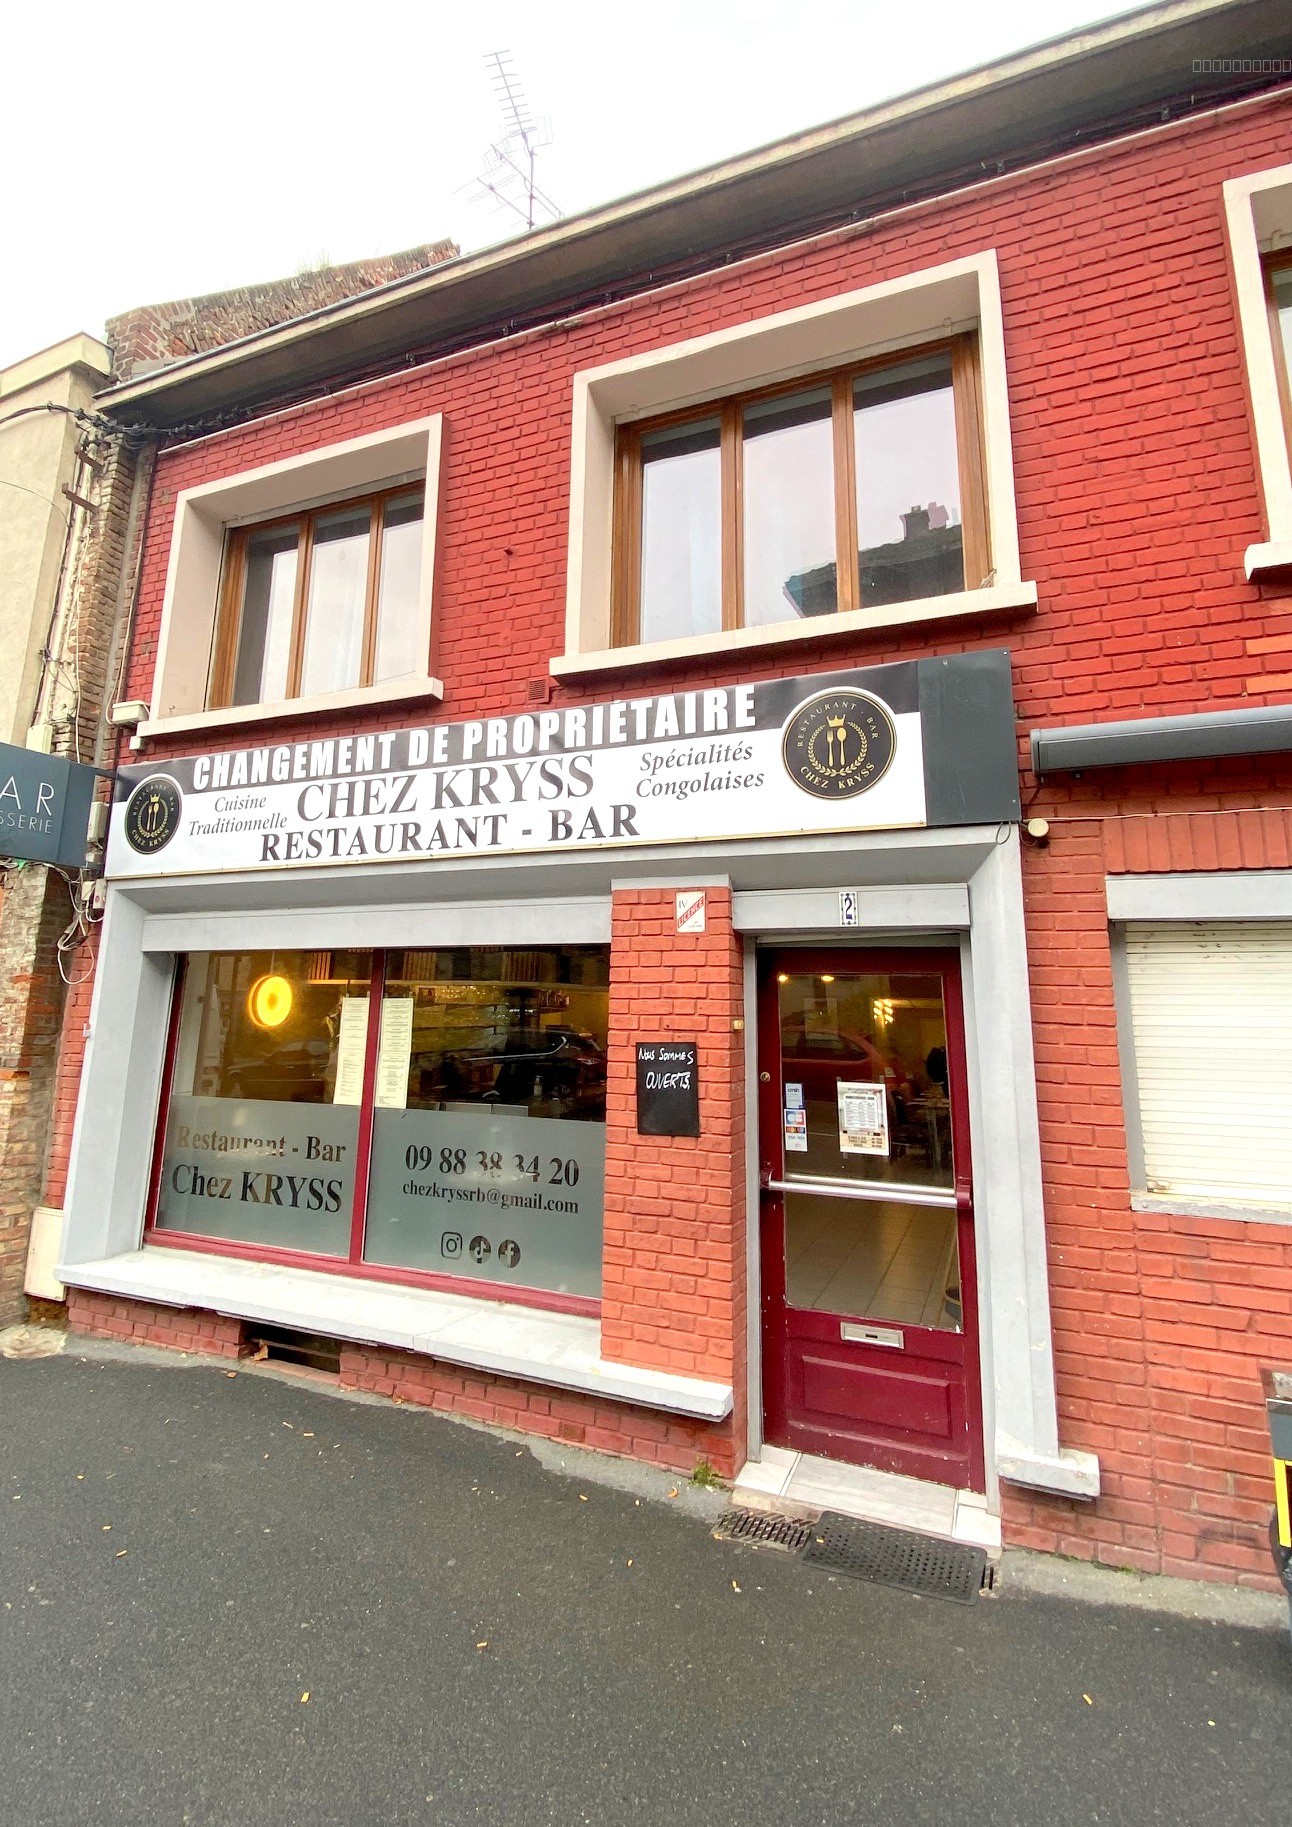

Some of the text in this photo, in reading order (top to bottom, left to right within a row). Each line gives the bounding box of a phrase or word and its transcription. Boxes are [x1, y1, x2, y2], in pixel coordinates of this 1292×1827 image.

[193, 685, 755, 790] CHANGEMENT DE PROPRIÉTAIRE
[797, 701, 879, 747] RESTAURANT BAR
[640, 741, 753, 776] Spécialités
[800, 763, 875, 789] CHEZ KRYSS
[0, 776, 52, 816] AR
[214, 796, 267, 812] Cuisine
[298, 754, 594, 822] CHEZ KRYSS
[636, 772, 765, 800] Congolaises
[189, 812, 287, 836] Traditionnelle
[259, 813, 508, 862] RESTAURANT
[548, 804, 640, 841] BAR
[844, 896, 853, 920] 2
[177, 1126, 286, 1157] Restaurant
[305, 1136, 346, 1162] Bar
[405, 1145, 432, 1170] 09
[439, 1148, 467, 1174] 88
[548, 1158, 579, 1186] 20
[172, 1164, 343, 1212] Chez KRYSS
[402, 1180, 578, 1213] chezkryssrb@gmail.com
